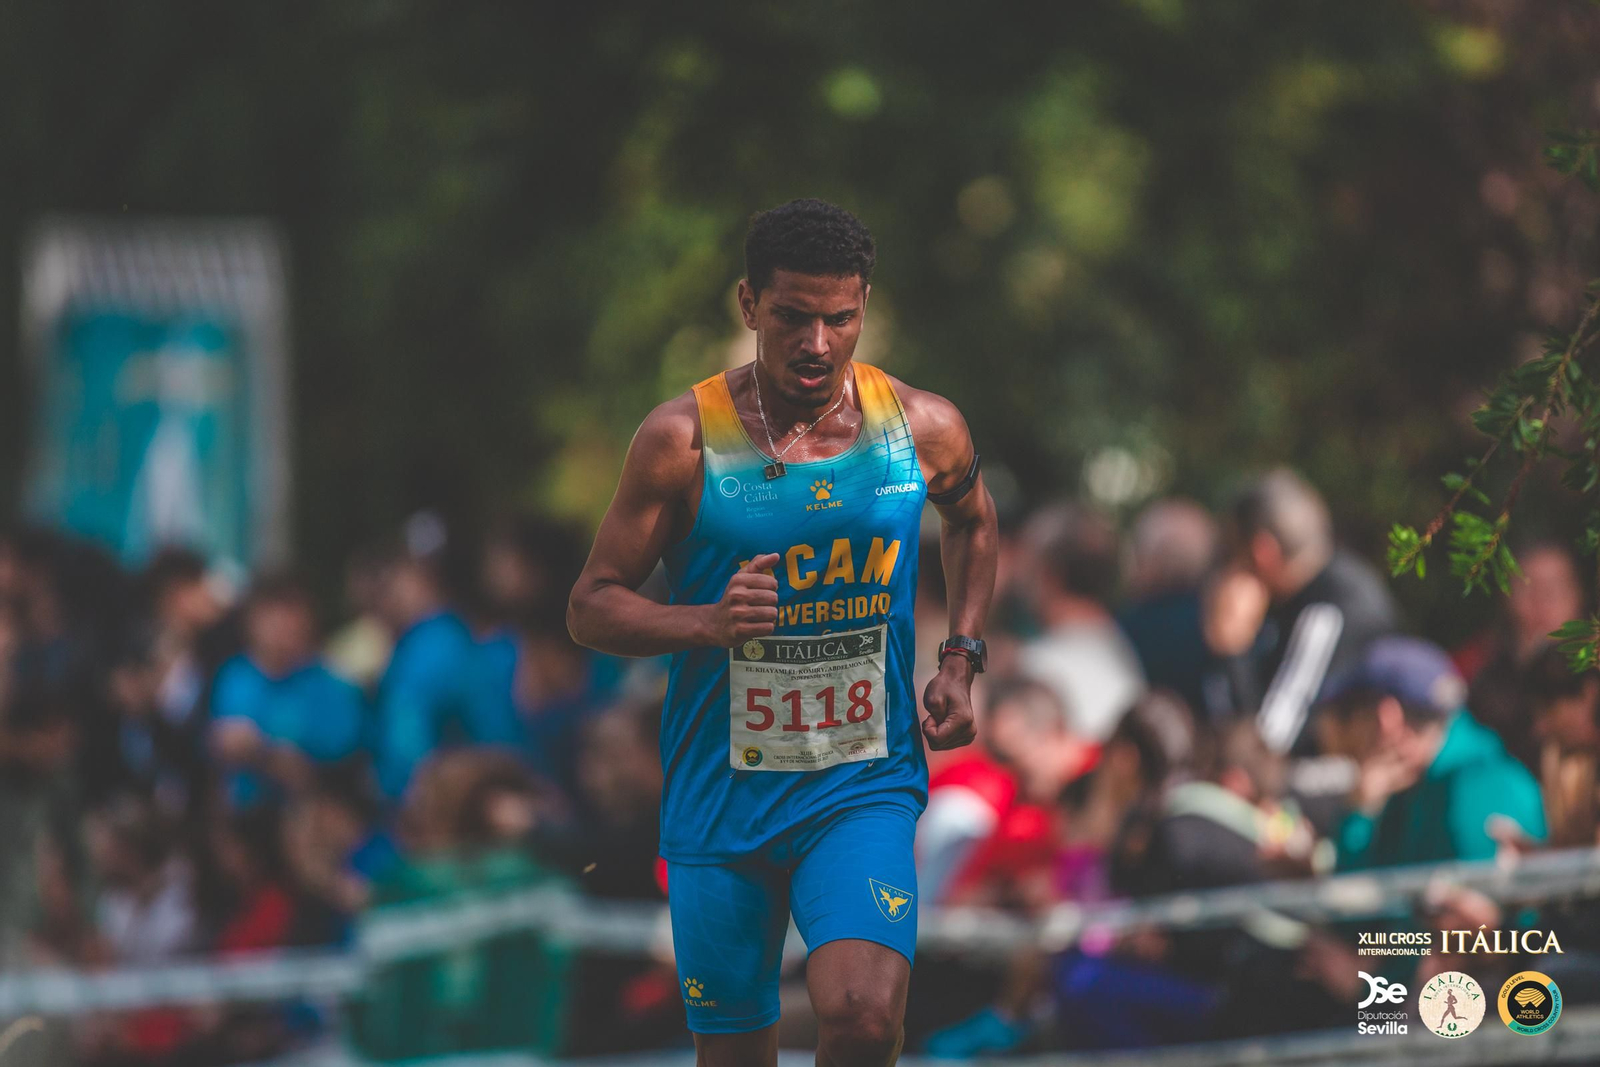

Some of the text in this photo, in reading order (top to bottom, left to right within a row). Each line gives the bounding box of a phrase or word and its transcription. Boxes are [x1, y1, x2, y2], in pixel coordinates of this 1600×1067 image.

[743, 482, 772, 492] Costa
[875, 482, 919, 496] CARTAGENA
[744, 491, 778, 503] Cálida
[806, 500, 843, 512] KELME
[739, 537, 901, 591] CAM
[775, 641, 848, 660] ITÁLICA
[745, 679, 874, 732] 5118
